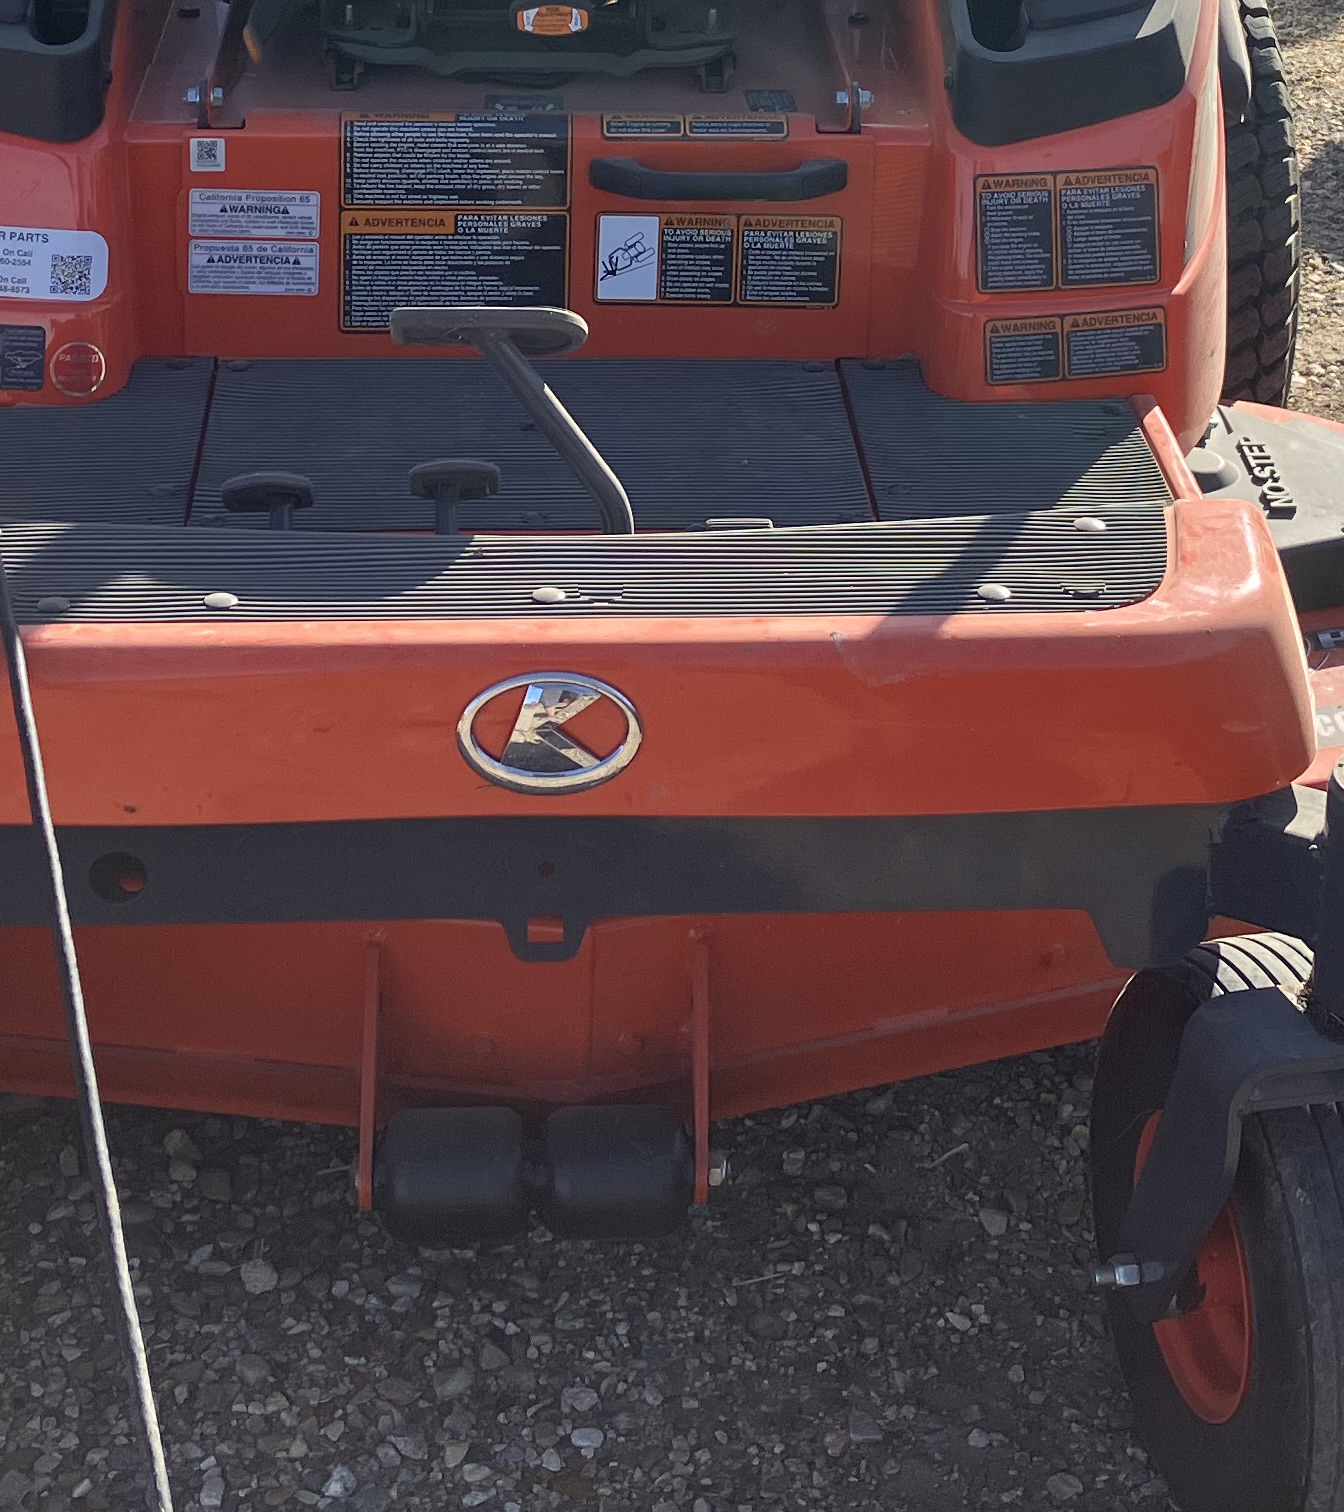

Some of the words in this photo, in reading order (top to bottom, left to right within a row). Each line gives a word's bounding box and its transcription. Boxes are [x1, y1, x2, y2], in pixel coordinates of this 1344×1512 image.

[993, 177, 1048, 189] WARNING
[1074, 172, 1150, 186] ADVERTENCIA
[199, 193, 243, 202] California
[245, 194, 297, 203] Proposition
[299, 195, 311, 203] 65
[229, 205, 281, 215] WARNING
[363, 217, 446, 228] ADVERTENCIA
[675, 217, 730, 226] WARNING
[754, 219, 835, 229] ADVERTENCIA
[9, 231, 49, 243] PARTS
[2, 248, 15, 257] On
[17, 249, 33, 257] Call
[193, 243, 240, 254] Propuesta
[256, 245, 268, 253] de
[270, 245, 314, 254] California
[216, 255, 291, 265] ADVERTENCIA
[11, 276, 27, 284] Call
[1080, 312, 1158, 328] ADVERTENCIA
[1001, 320, 1056, 333] WARNING
